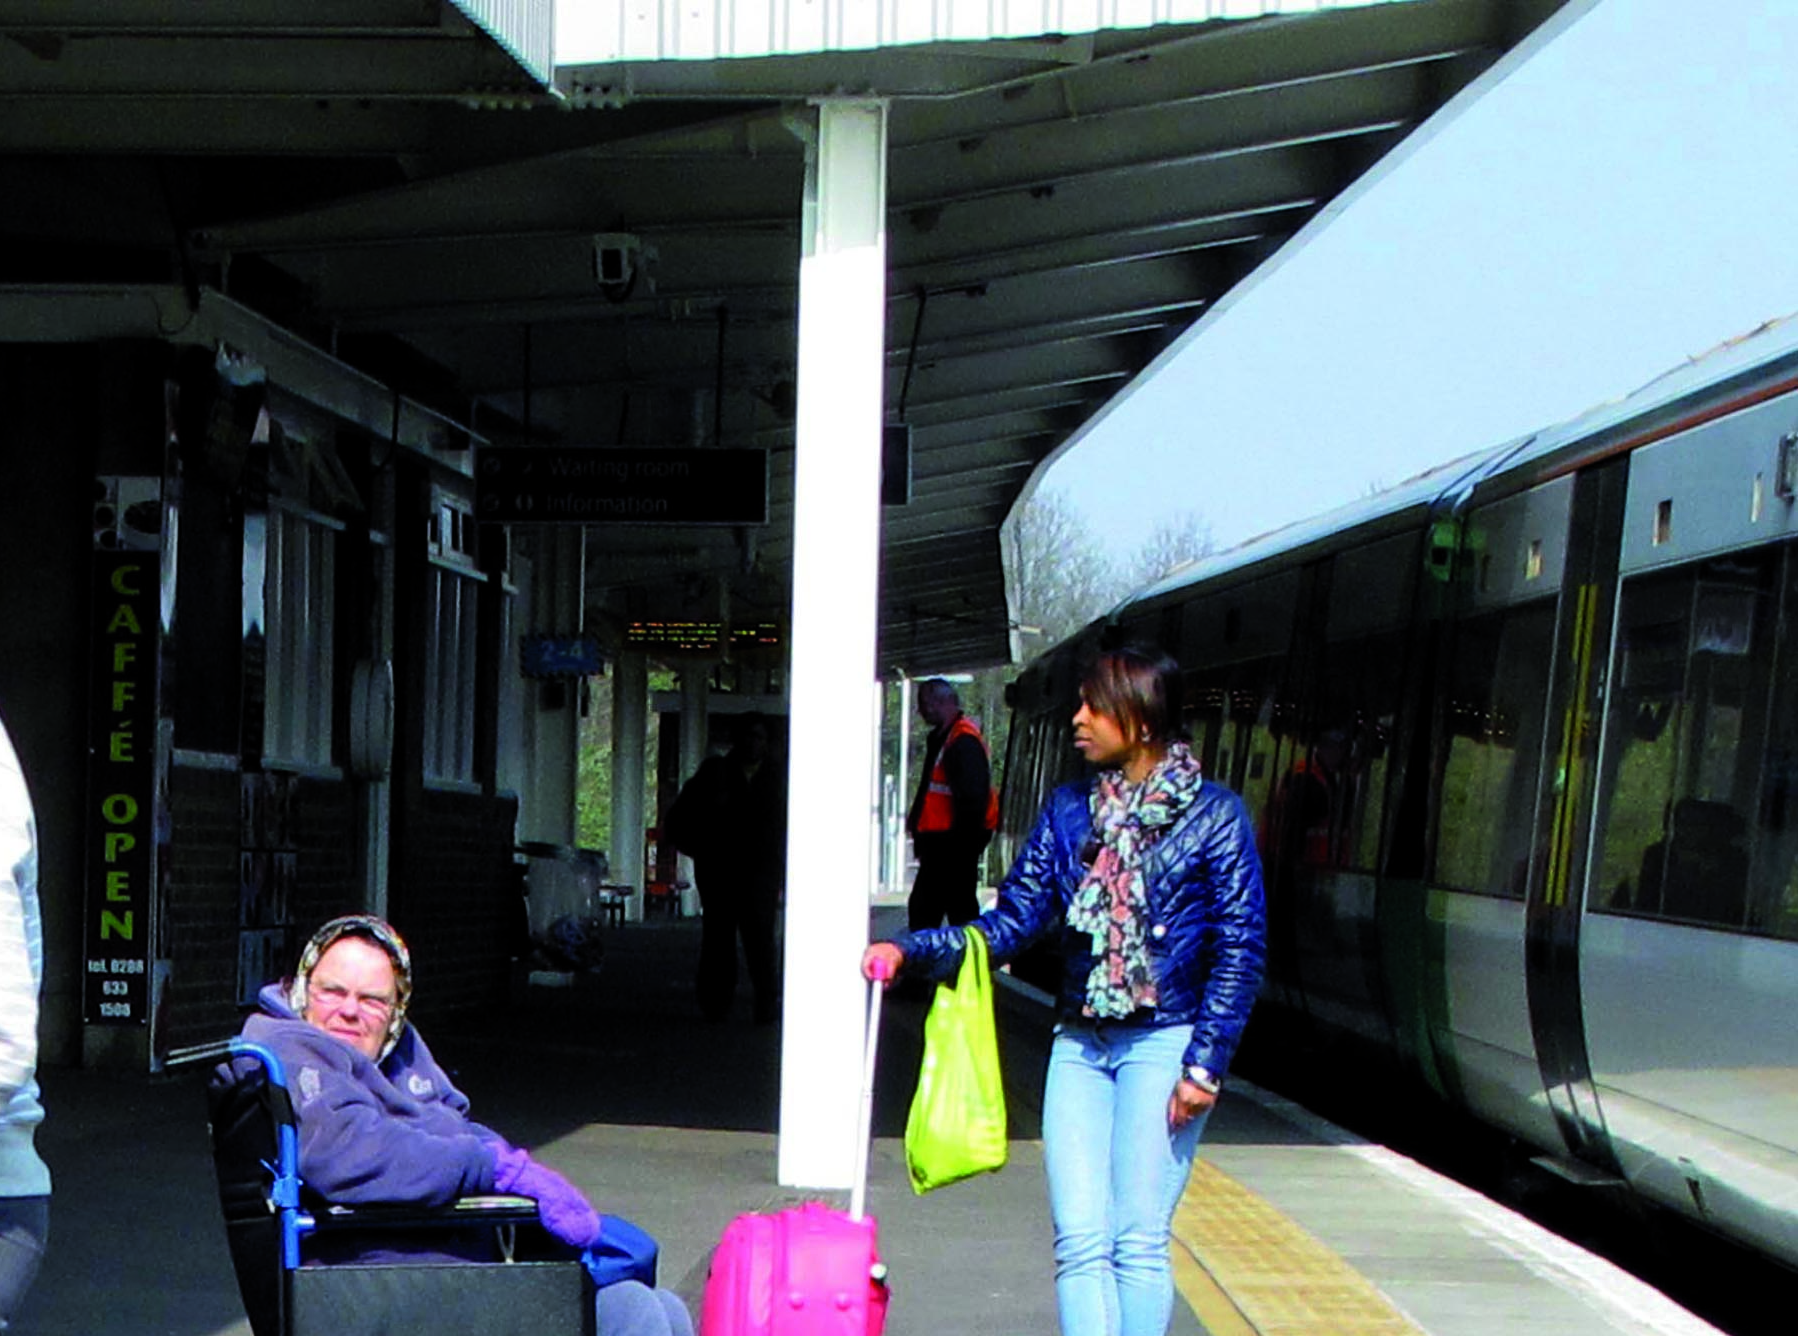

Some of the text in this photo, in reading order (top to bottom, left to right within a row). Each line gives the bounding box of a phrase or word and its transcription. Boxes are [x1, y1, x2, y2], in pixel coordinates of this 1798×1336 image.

[547, 455, 691, 483] Waiting room
[546, 493, 669, 514] Information
[99, 564, 142, 942] CAFFÉ OPEN
